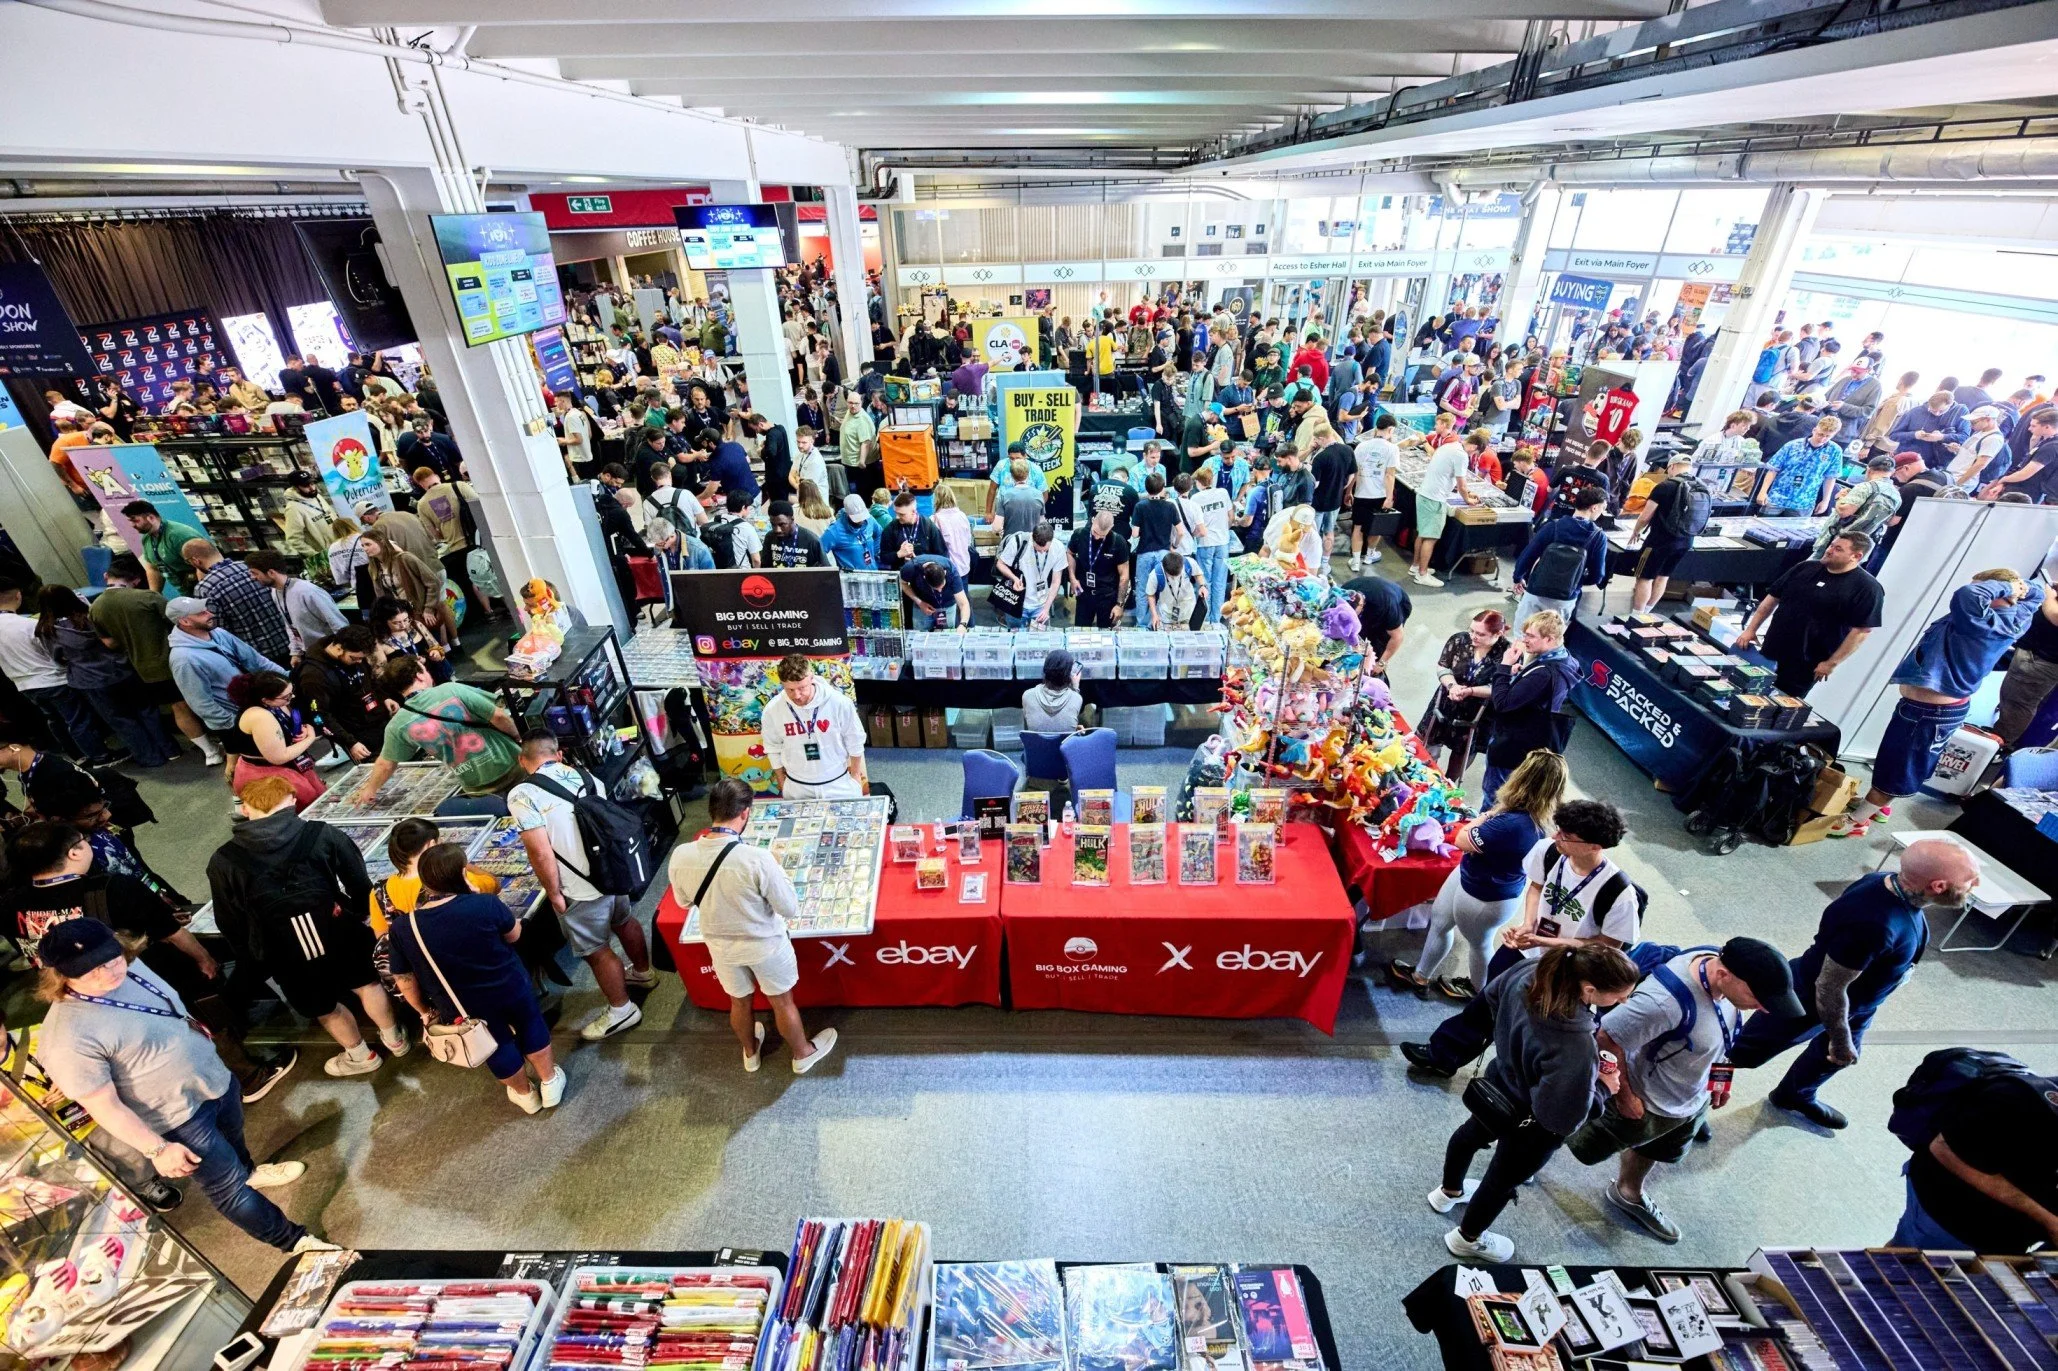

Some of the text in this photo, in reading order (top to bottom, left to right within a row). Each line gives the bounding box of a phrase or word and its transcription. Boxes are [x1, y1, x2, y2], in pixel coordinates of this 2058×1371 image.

[626, 228, 680, 248] COFFEE HOUSE
[1273, 262, 1298, 270] Access
[1387, 260, 1406, 268] Main
[1407, 259, 1427, 269] Foyer
[1574, 258, 1650, 270] Exit via Main Foyer
[1554, 281, 1594, 302] BUYING
[2, 320, 38, 332] SHOW
[990, 340, 1008, 348] CLA
[1014, 394, 1035, 408] BUY
[1046, 392, 1071, 407] SELL
[1024, 408, 1058, 422] TRADE
[1608, 408, 1624, 432] 10
[1042, 457, 1062, 471] FECK
[141, 482, 174, 492] LONIC
[1098, 484, 1124, 496] VANS
[770, 544, 783, 552] the
[994, 583, 1020, 601] LONDON
[716, 610, 808, 622] BIG BOX GAMING
[722, 637, 842, 650] ebay @ BIG_BOX_GAMING
[1612, 674, 1682, 736] STACKED &
[1606, 684, 1674, 748] PACKED
[1140, 798, 1164, 814] HULK
[1080, 838, 1105, 850] HULK
[876, 940, 978, 970] ebay
[1216, 944, 1324, 978] ebay
[1056, 964, 1080, 974] BOX
[1082, 964, 1128, 973] GAMING
